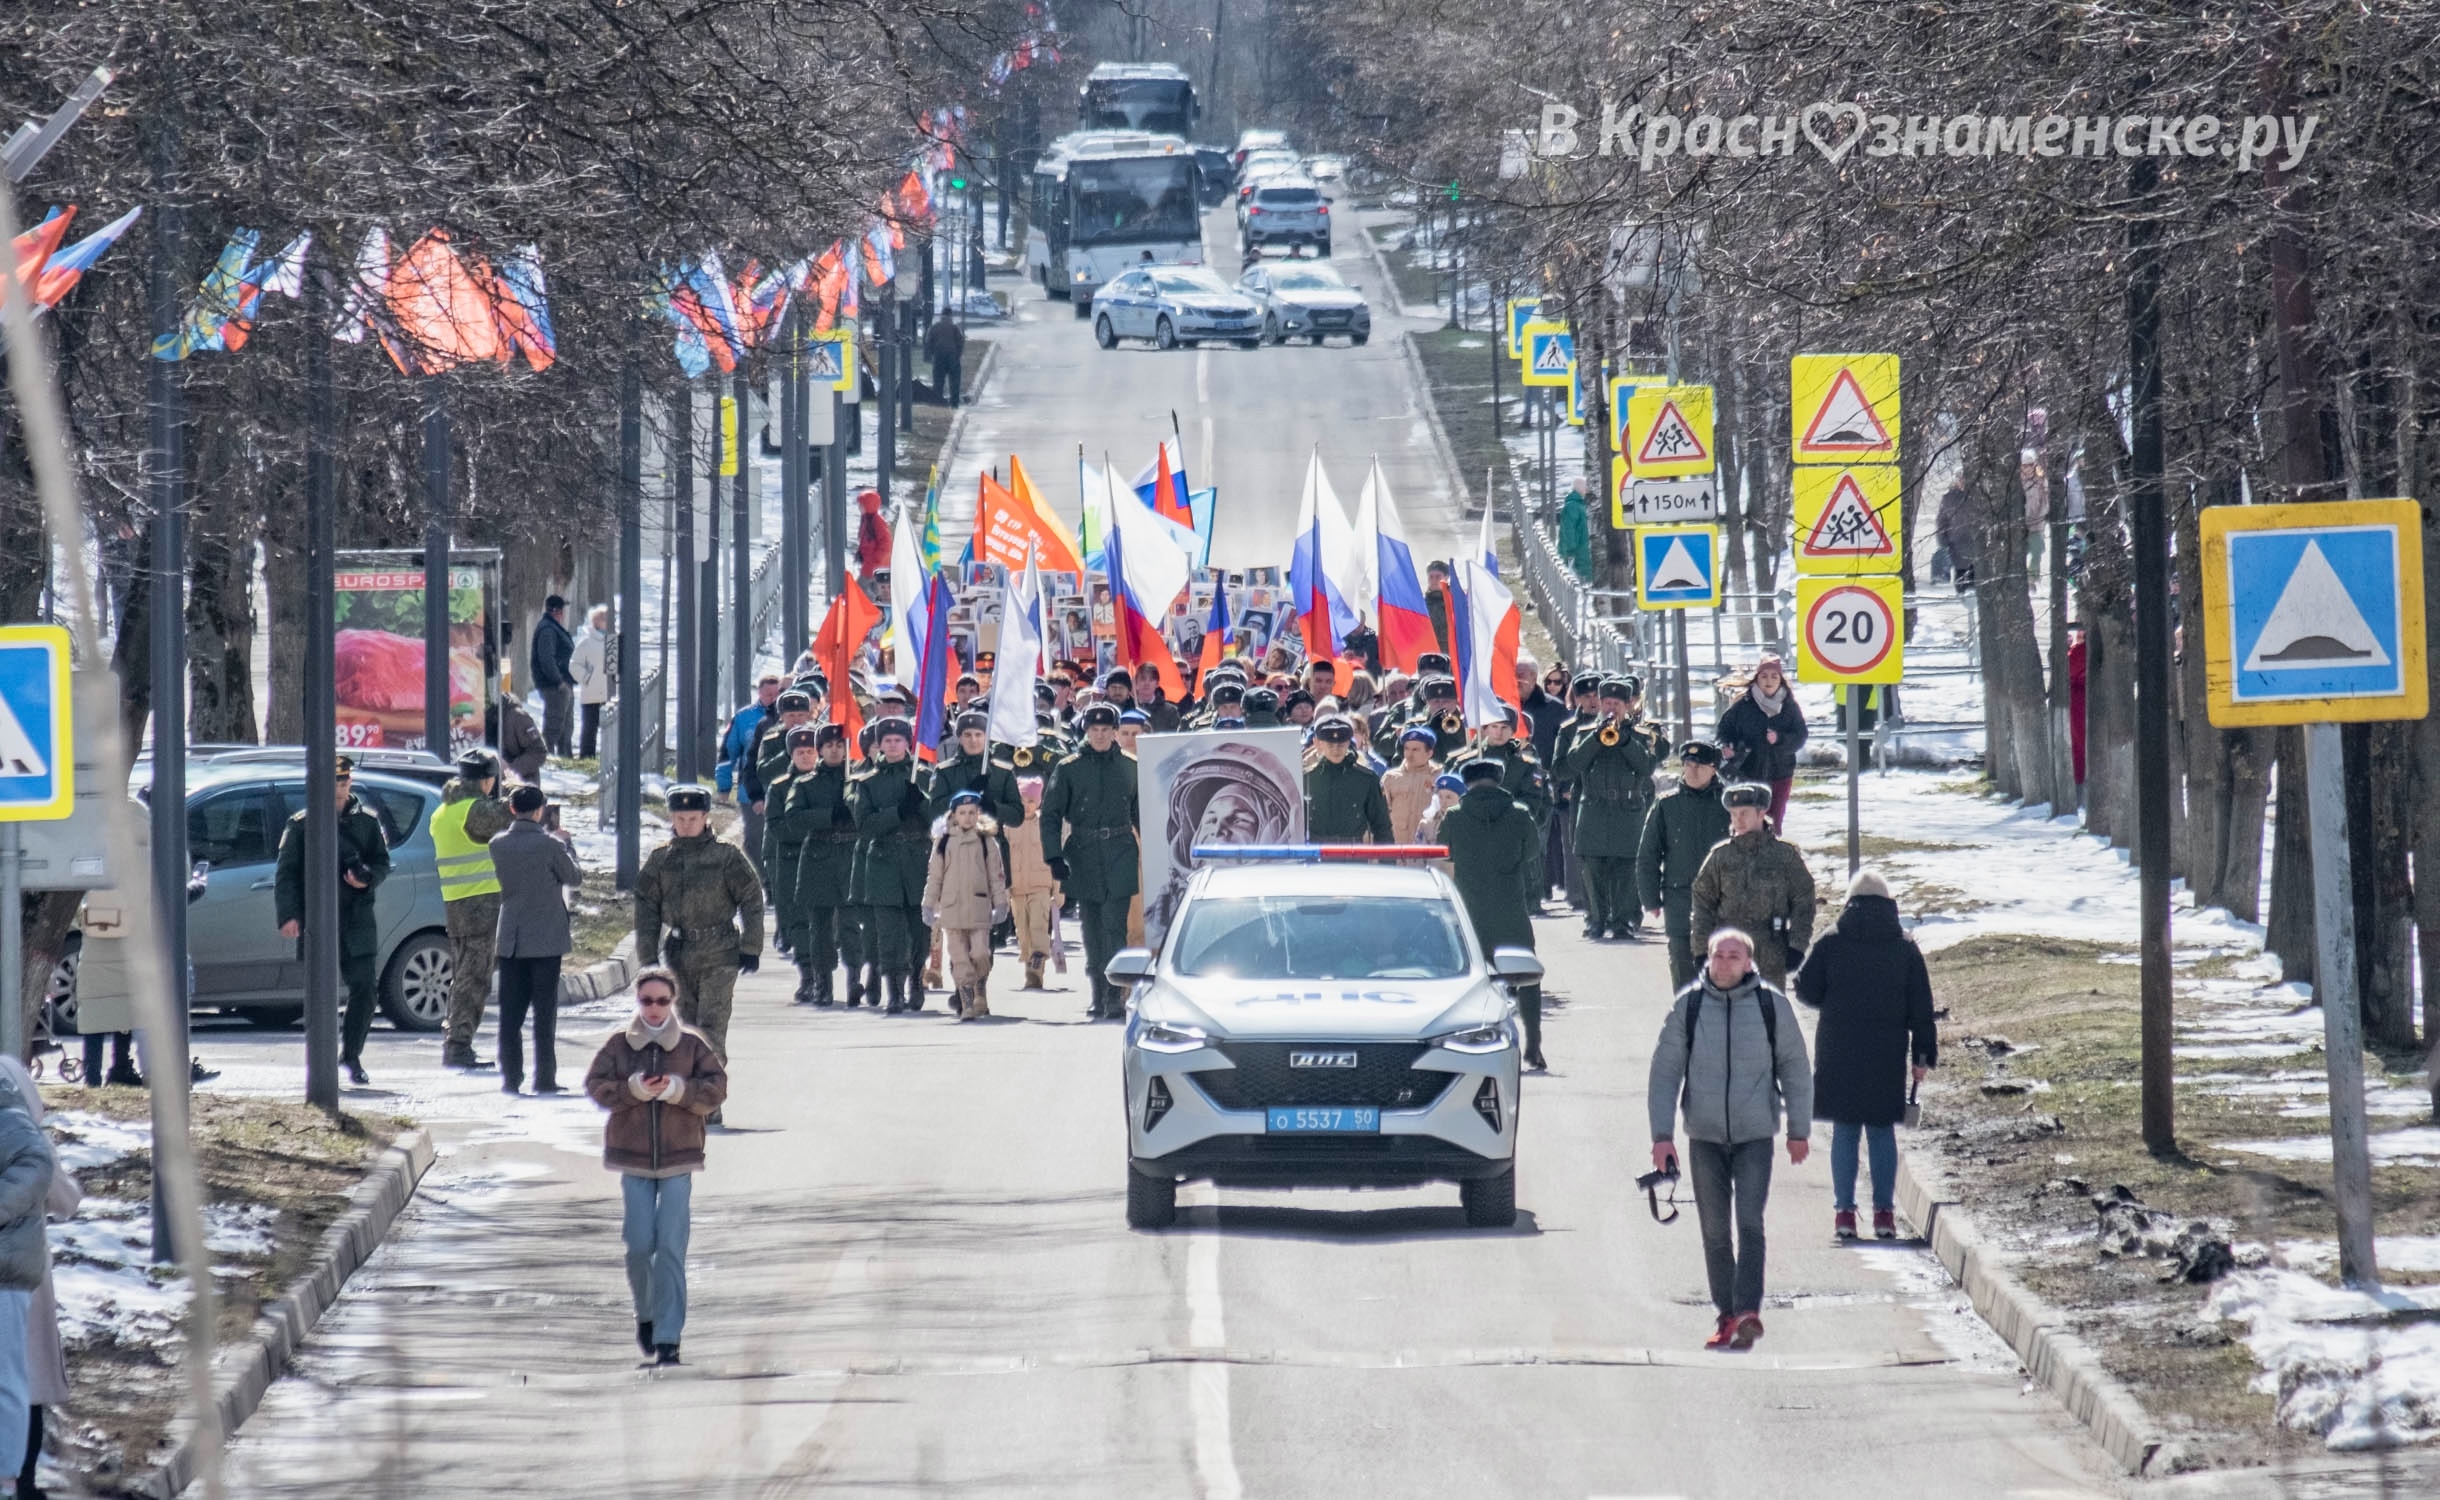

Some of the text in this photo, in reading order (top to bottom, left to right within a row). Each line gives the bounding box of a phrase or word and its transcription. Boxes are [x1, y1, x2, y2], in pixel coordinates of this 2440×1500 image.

[334, 573, 454, 589] UROSP
[1825, 610, 1874, 644] 20
[1296, 1111, 1343, 1130] 5537
[1354, 1109, 1373, 1125] 50
